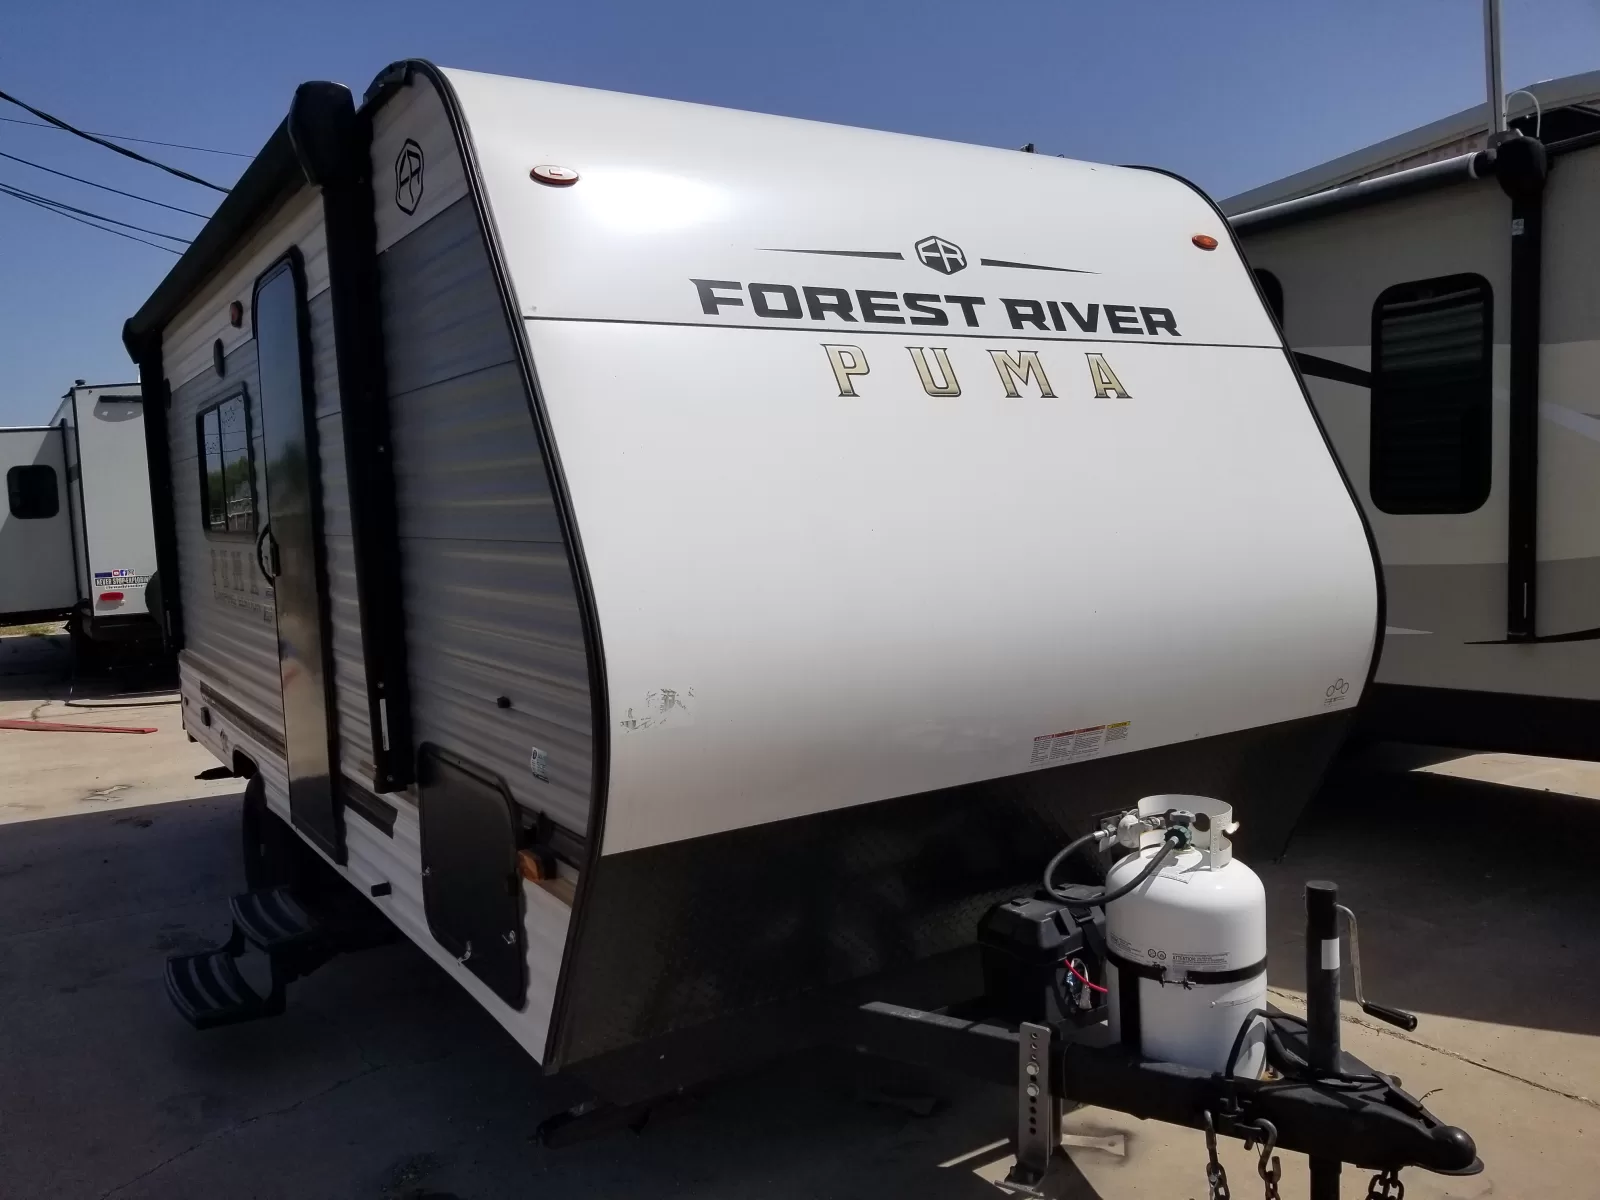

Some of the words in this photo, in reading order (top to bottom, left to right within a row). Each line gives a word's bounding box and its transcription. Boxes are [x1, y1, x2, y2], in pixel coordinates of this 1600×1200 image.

[917, 237, 966, 273] FR
[689, 278, 986, 328] FOREST
[998, 297, 1183, 337] RIVER
[820, 343, 1133, 399] PUMA
[96, 578, 112, 587] NEVER
